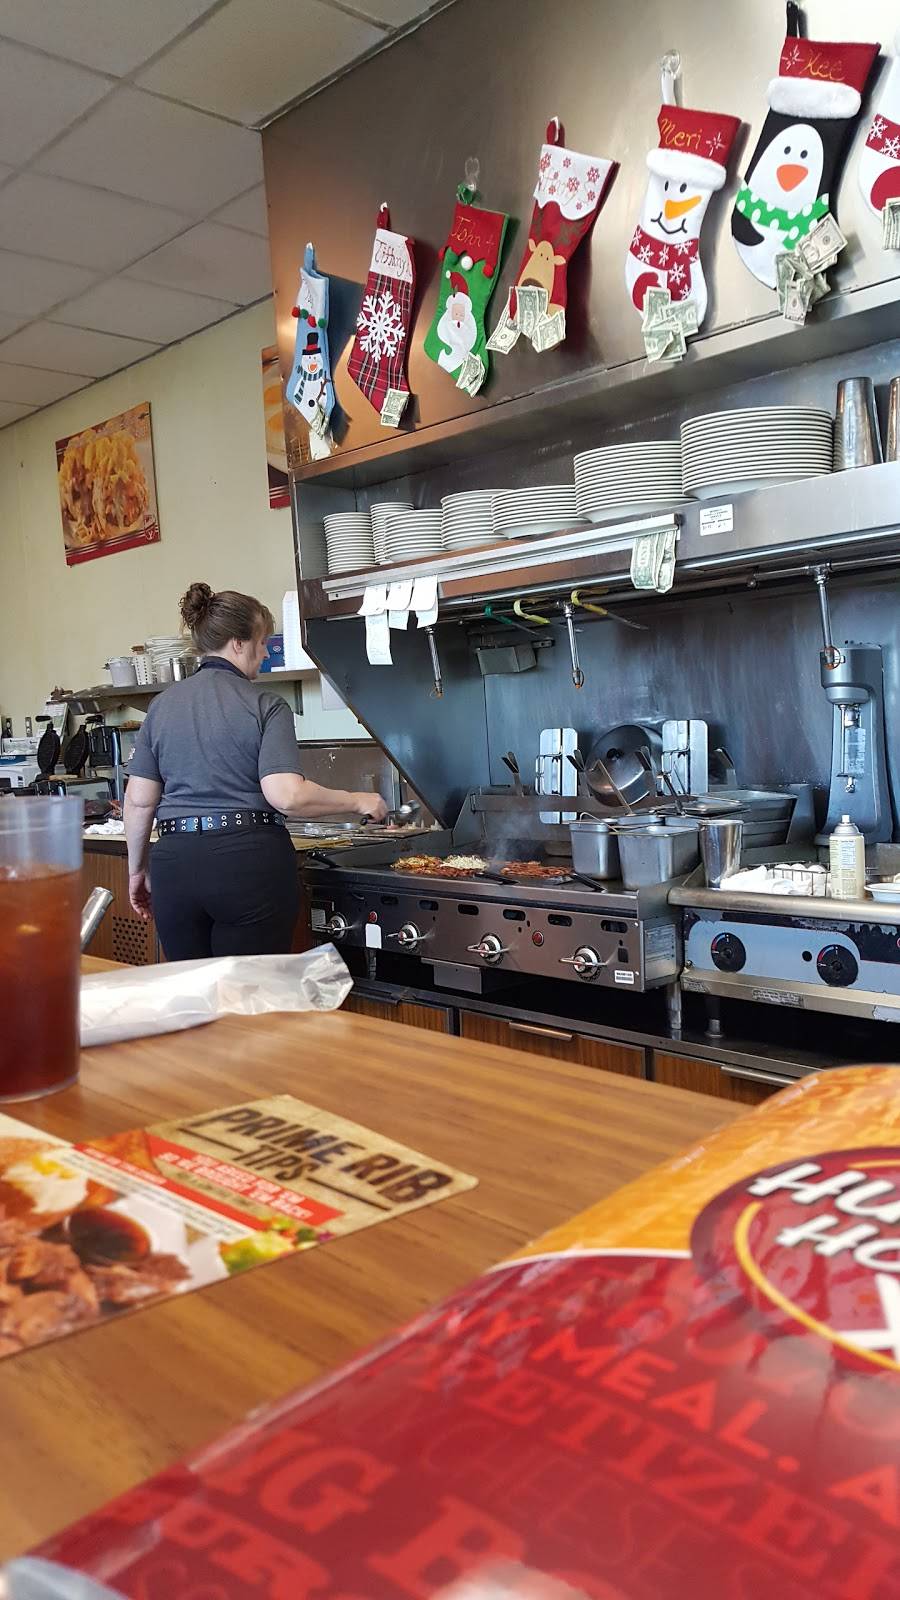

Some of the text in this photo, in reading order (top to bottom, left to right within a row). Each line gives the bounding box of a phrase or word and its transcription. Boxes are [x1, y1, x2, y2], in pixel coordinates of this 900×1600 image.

[660, 118, 703, 151] Meri
[189, 1107, 454, 1203] PRIME RIB
[232, 1143, 322, 1182] TIPS
[528, 1325, 799, 1474] MEAL.
